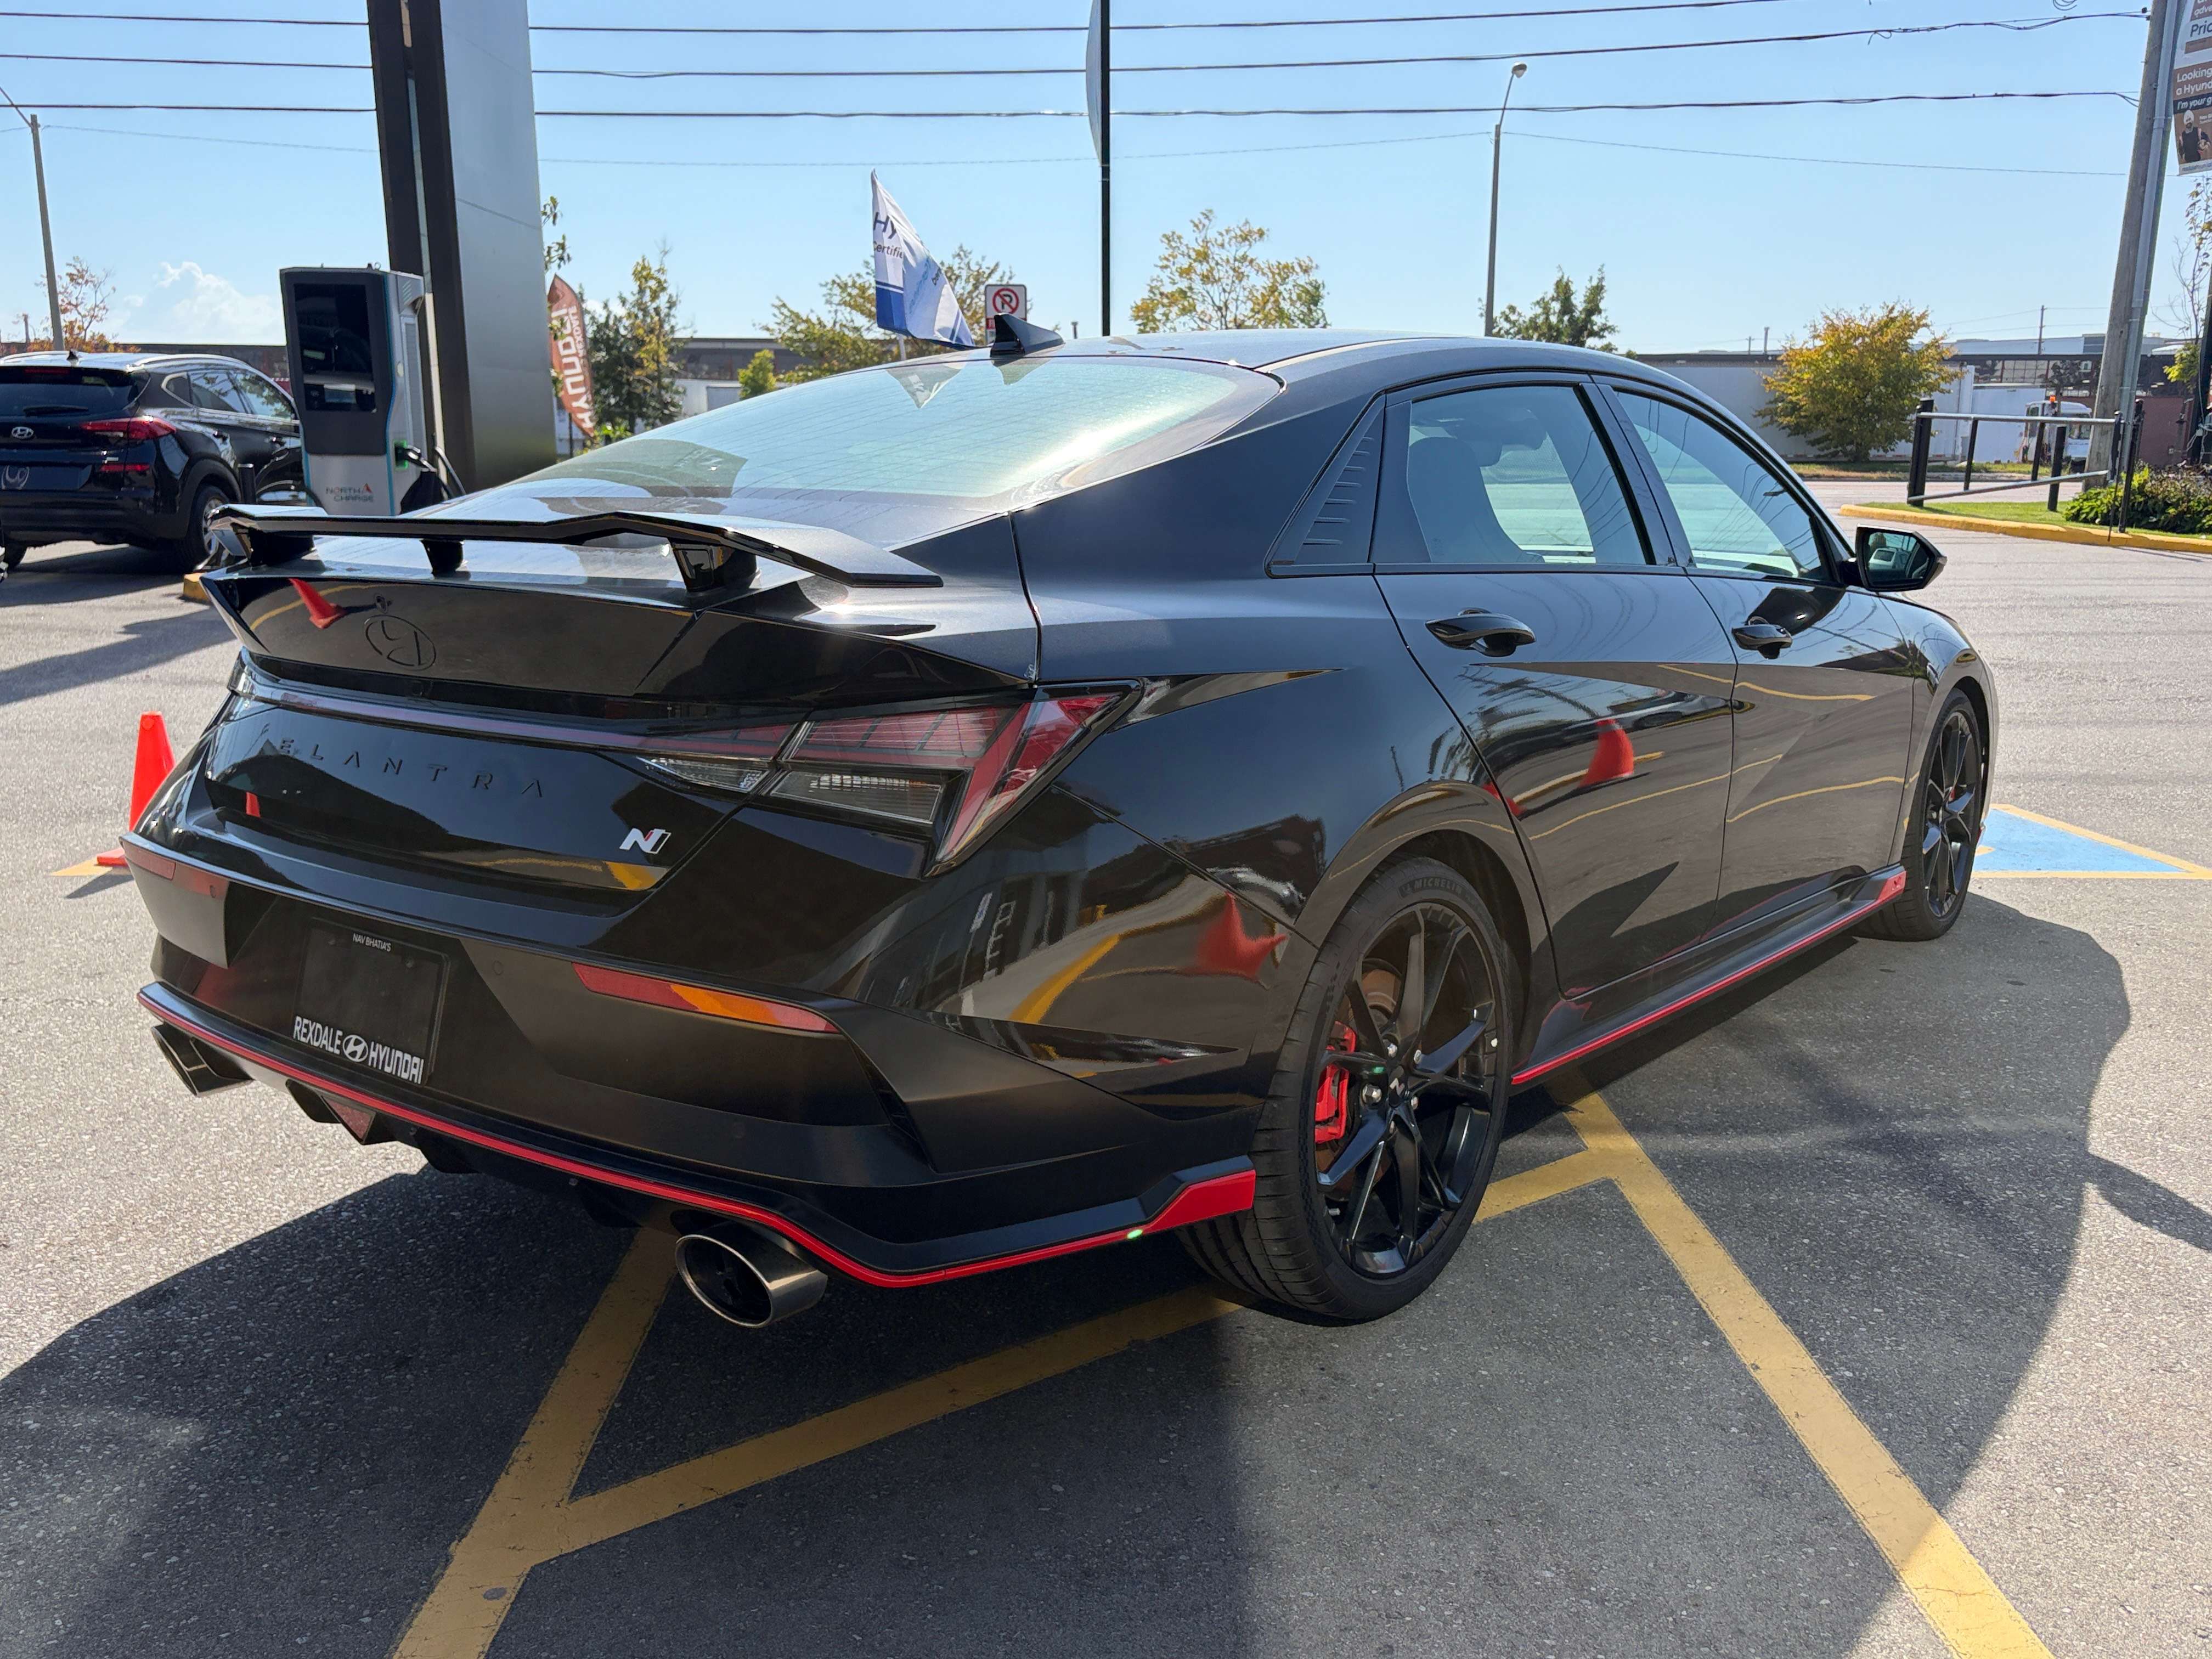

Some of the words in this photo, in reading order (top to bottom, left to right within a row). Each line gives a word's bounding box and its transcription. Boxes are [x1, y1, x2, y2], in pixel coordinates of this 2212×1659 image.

[2177, 67, 2212, 83] Looking
[2176, 87, 2182, 95] a
[2177, 101, 2188, 110] I'm
[2189, 97, 2206, 109] your
[280, 737, 543, 798] ELANTRA
[1413, 877, 1463, 894] MICHELIN
[353, 933, 366, 945] NAV
[365, 937, 392, 952] BHATIA'S
[293, 1015, 343, 1055] REXDALE
[368, 1041, 425, 1085] HYUNDAI
